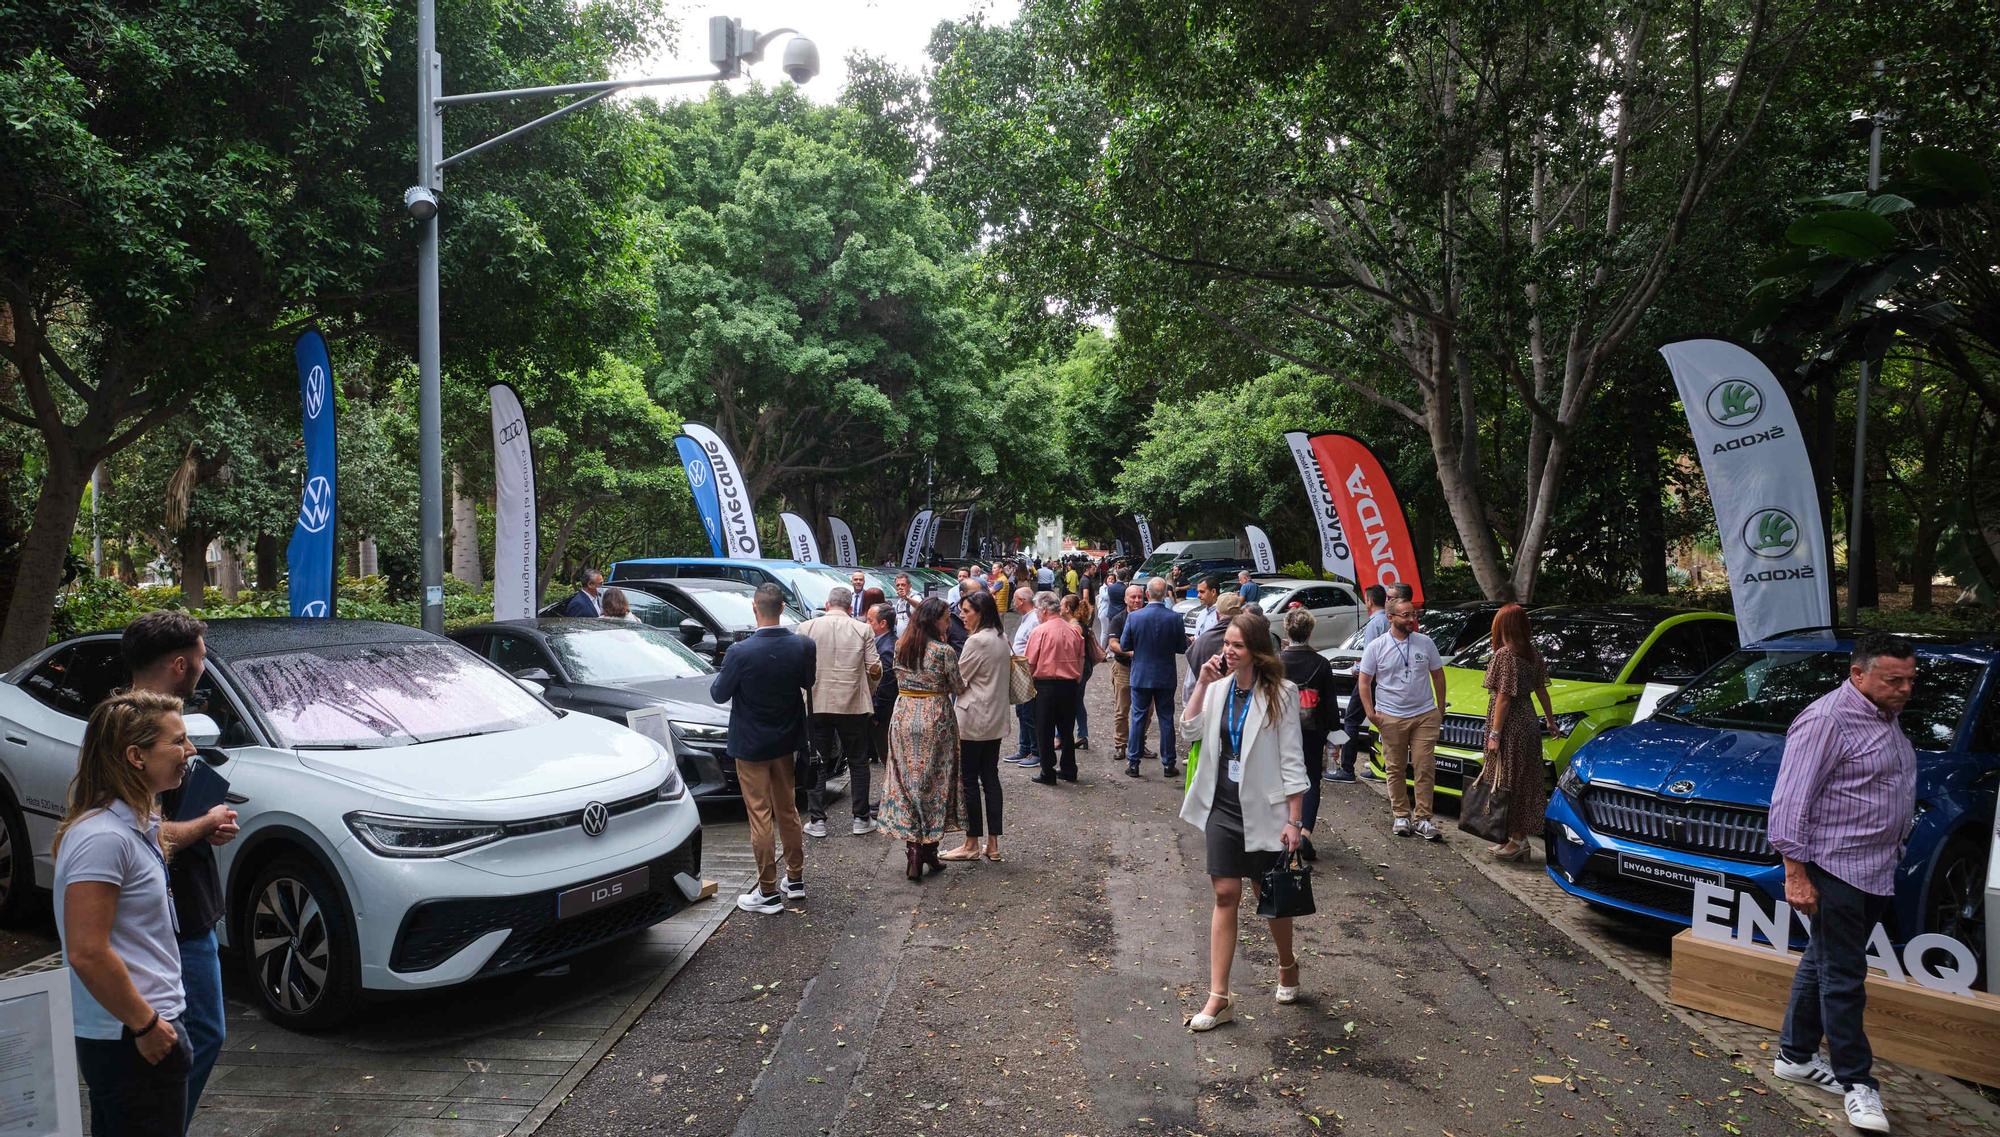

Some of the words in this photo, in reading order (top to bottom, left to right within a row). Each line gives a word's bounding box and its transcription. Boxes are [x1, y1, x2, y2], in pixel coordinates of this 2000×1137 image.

[1346, 463, 1401, 592] ONDA
[592, 883, 622, 903] ID.5
[1624, 861, 1652, 874] ENYAQ
[1654, 868, 1704, 884] SPORTLINE
[1692, 881, 1979, 998] ENAQ
